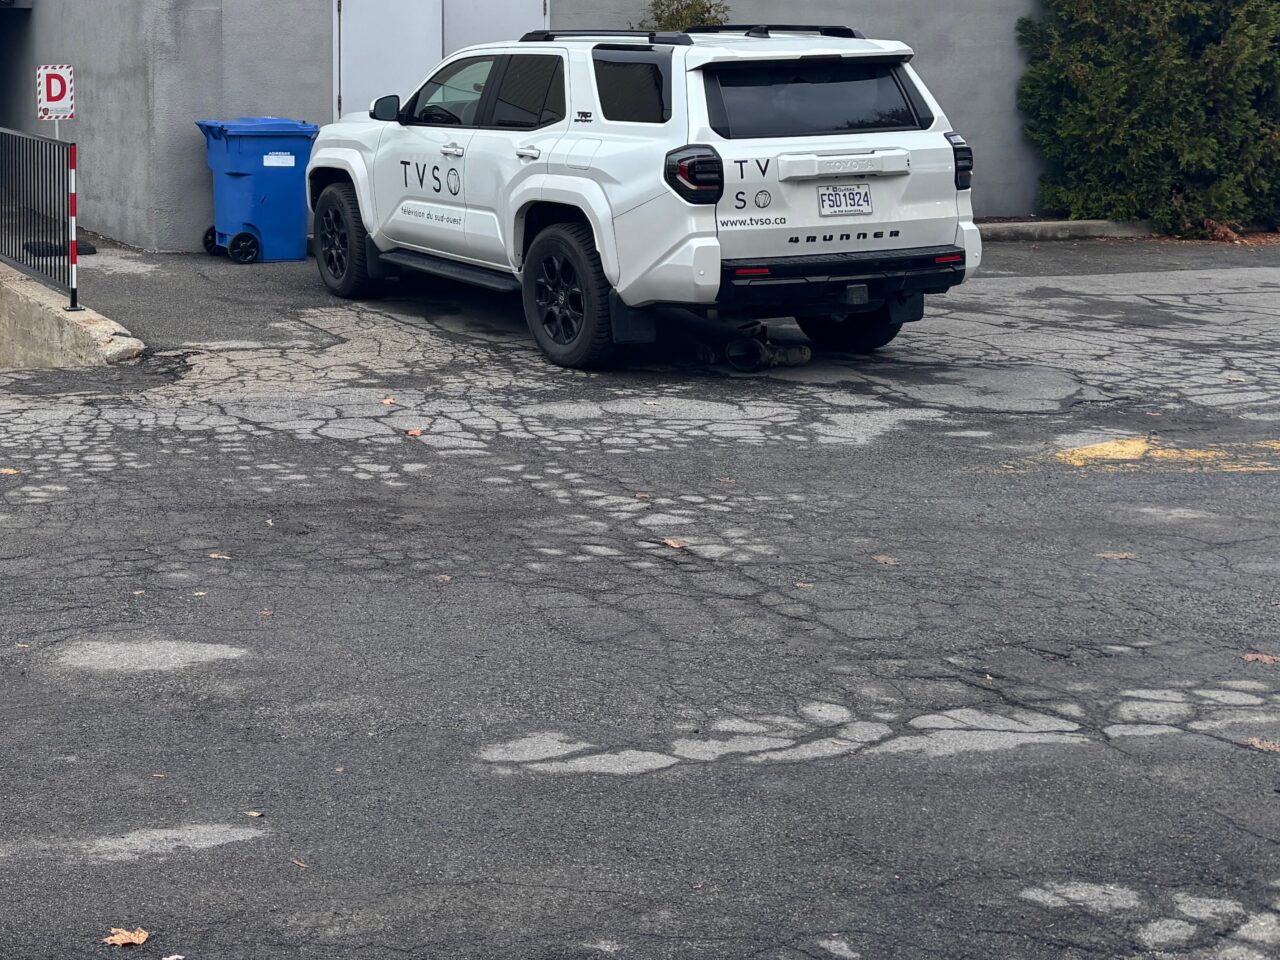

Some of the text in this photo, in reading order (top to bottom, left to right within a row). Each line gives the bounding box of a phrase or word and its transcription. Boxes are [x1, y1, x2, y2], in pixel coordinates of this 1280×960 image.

[46, 73, 67, 102] D
[734, 159, 770, 179] TV
[826, 159, 874, 170] TOYOTA
[820, 191, 870, 209] FSD1924
[401, 206, 461, 225] télévision du sud-ouest
[720, 216, 786, 227] www.tvso.ca
[788, 230, 900, 243] 4RUNNER
